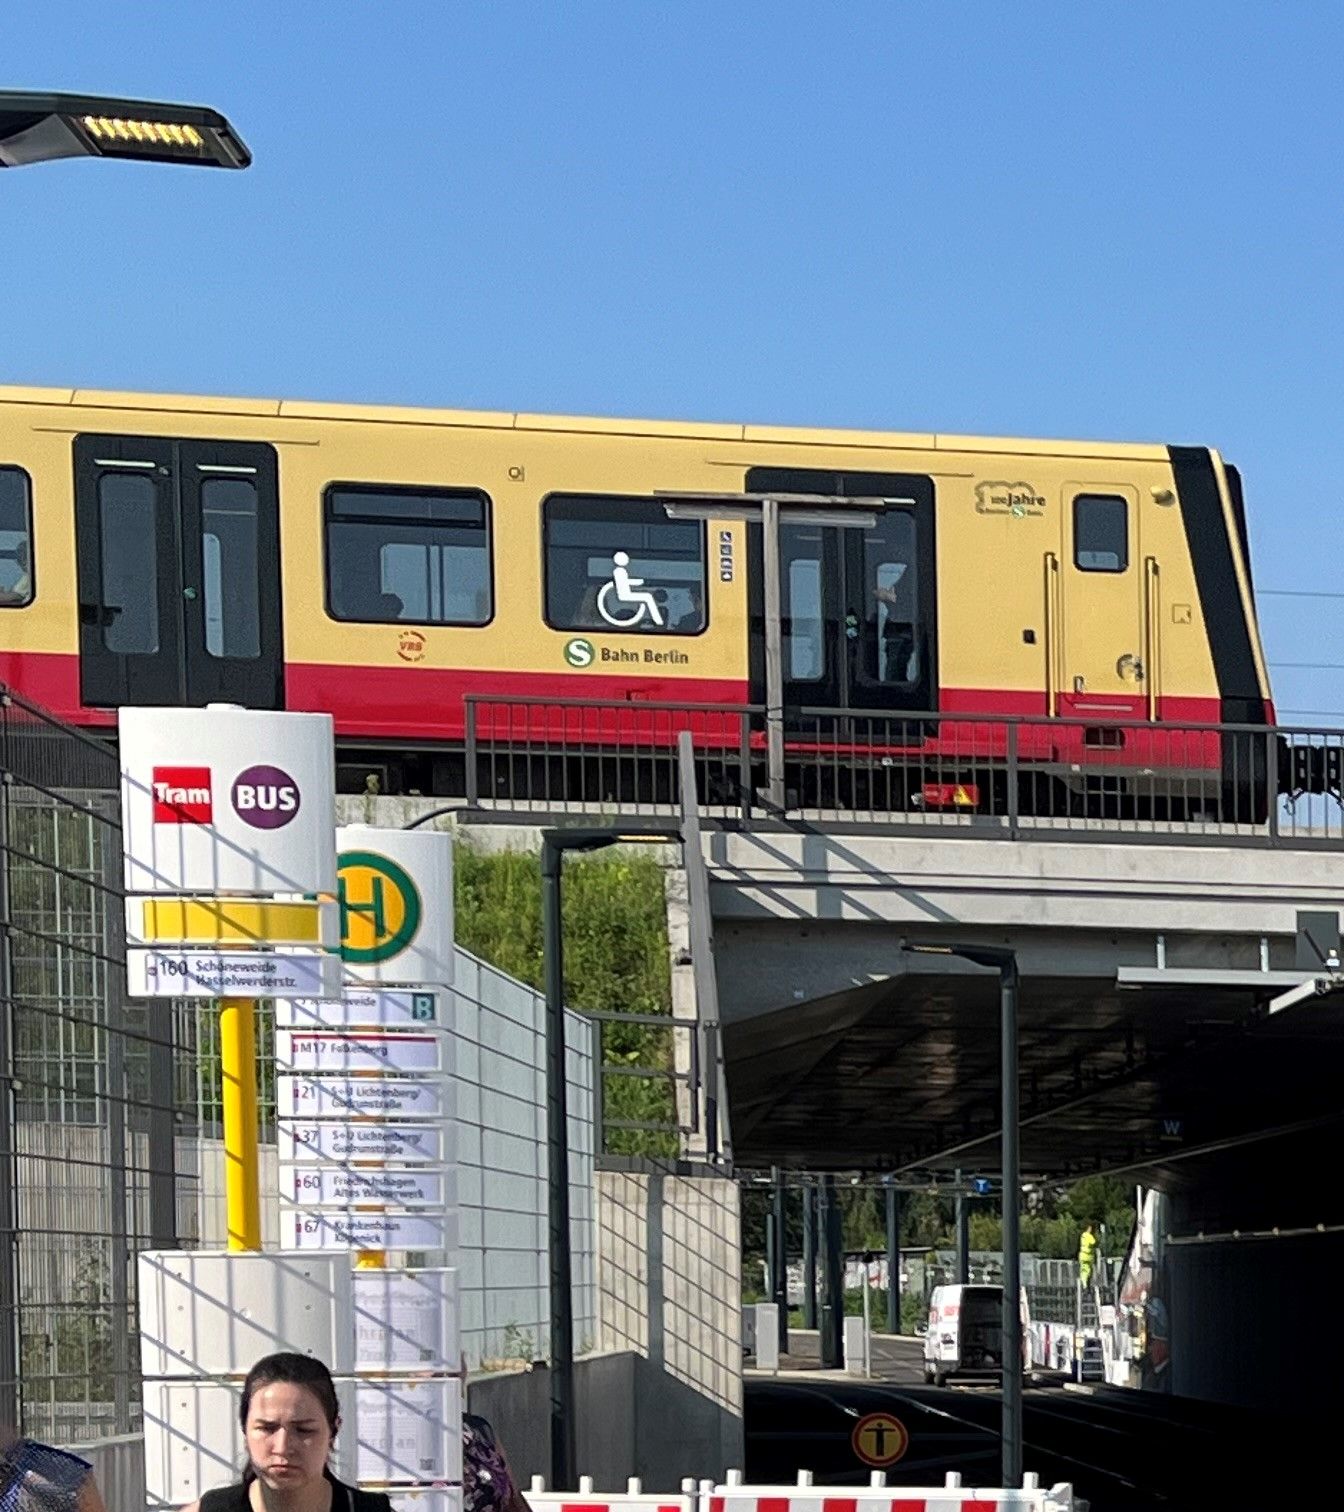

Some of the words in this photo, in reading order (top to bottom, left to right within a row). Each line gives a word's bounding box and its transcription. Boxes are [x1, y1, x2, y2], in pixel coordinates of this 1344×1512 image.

[568, 639, 591, 664] S
[601, 647, 639, 663] Bahn
[644, 649, 689, 664] Berlin
[154, 782, 210, 805] Tram
[236, 785, 296, 811] BUS
[337, 876, 386, 939] H
[195, 960, 277, 974] Schöneweide
[416, 998, 432, 1020] B
[301, 1042, 327, 1053] M17
[302, 1086, 315, 1099] 21
[302, 1130, 319, 1143] 37
[303, 1176, 321, 1189] 60
[304, 1220, 319, 1233] 67
